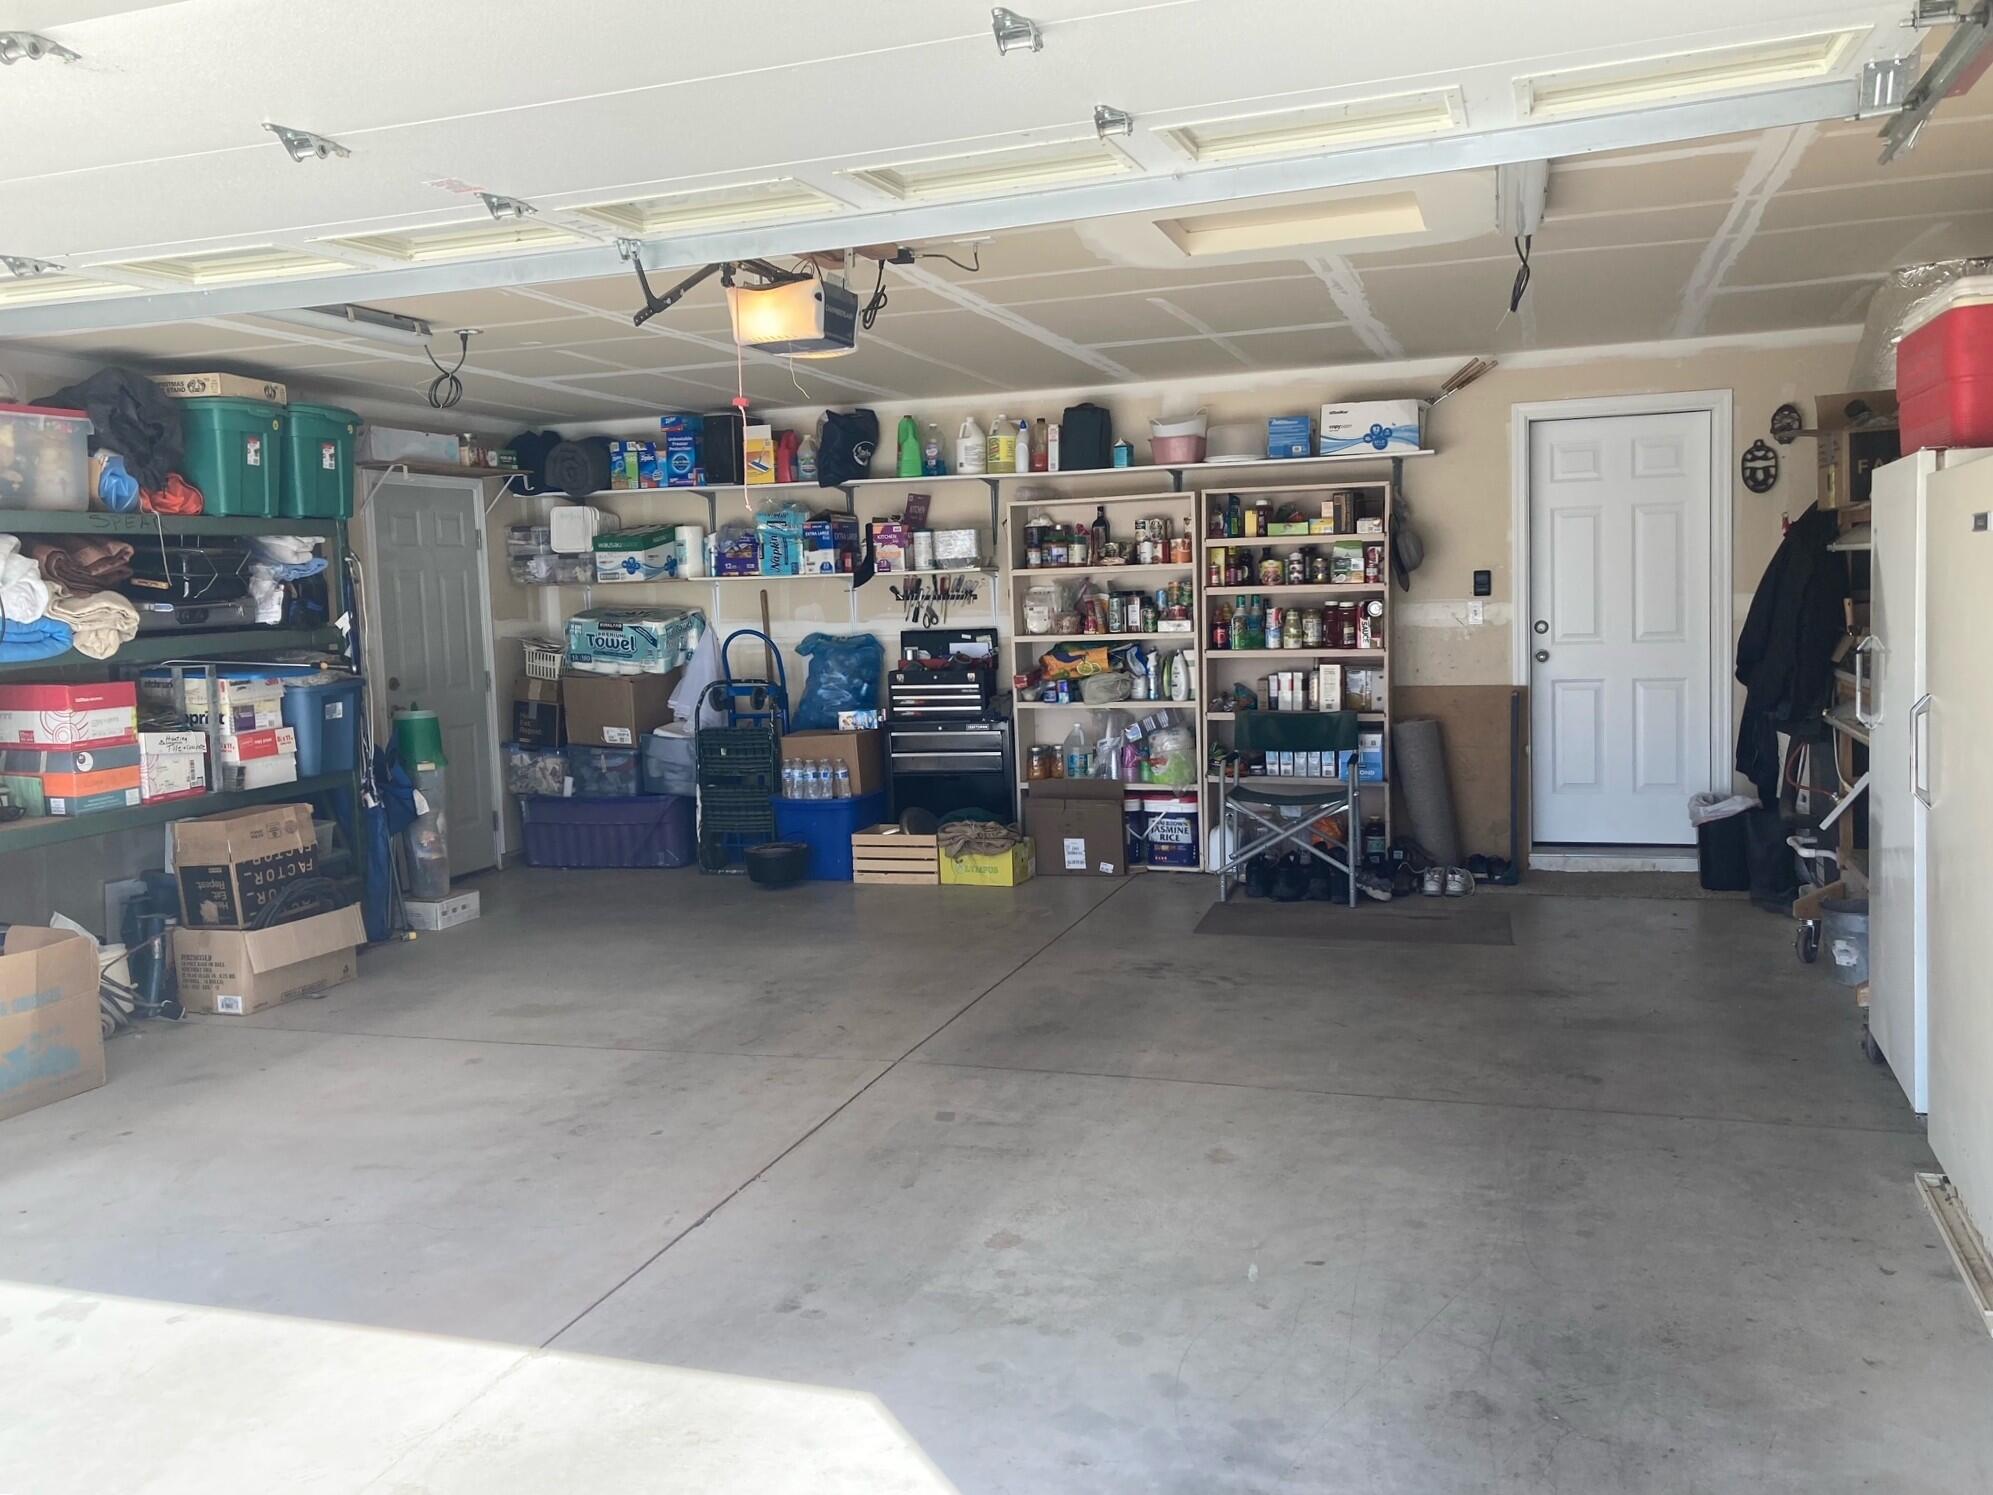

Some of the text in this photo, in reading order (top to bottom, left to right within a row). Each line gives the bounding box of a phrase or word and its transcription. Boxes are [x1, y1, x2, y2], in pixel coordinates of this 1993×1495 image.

[1361, 621, 1371, 643] SAUCE
[586, 633, 636, 651] Towel
[1151, 825, 1189, 834] JASMINE
